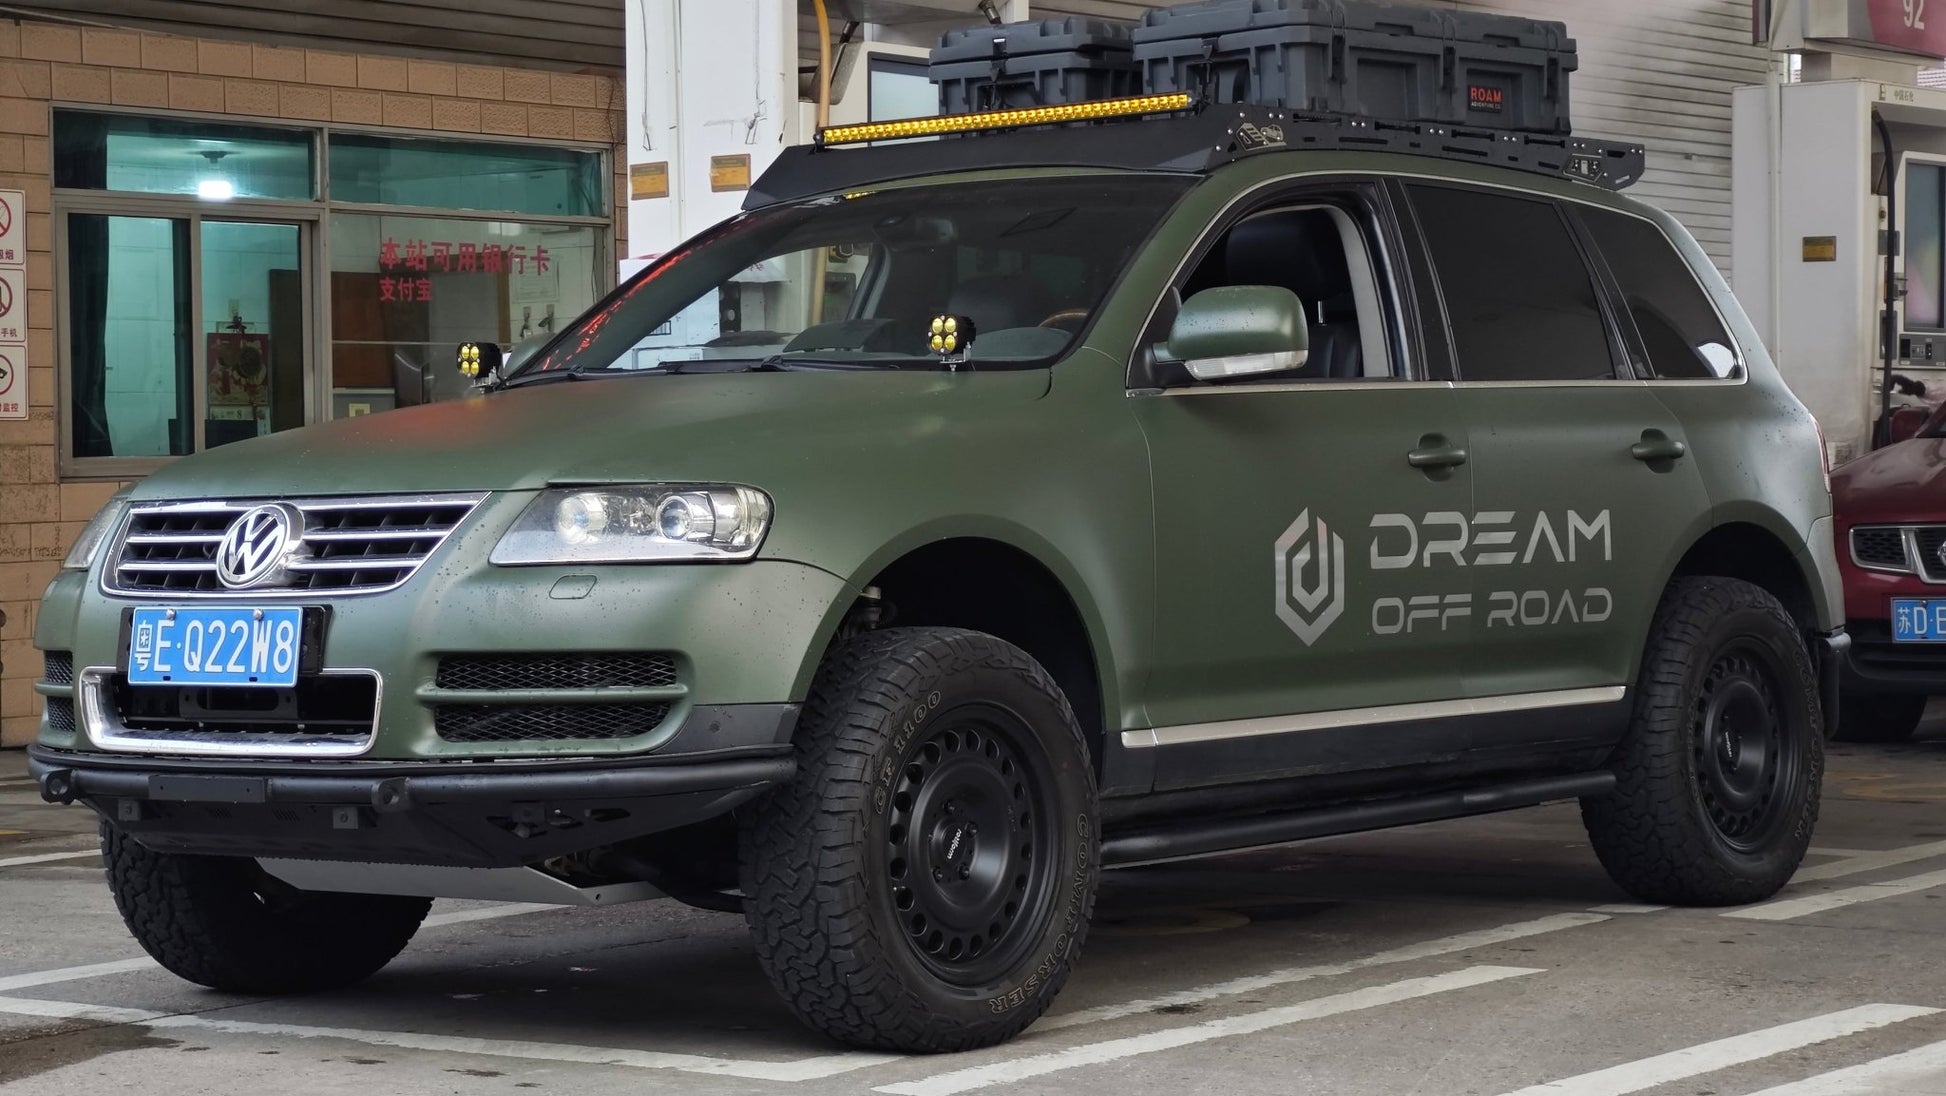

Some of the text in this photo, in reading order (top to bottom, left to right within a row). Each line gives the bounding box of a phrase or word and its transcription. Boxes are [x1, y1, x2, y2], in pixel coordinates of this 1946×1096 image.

[1903, 0, 1925, 30] 92
[1471, 87, 1502, 103] ROAM
[379, 237, 551, 276] 本站可用银行卡
[379, 277, 432, 301] 支付宝
[1369, 509, 1613, 569] DREAM
[1372, 587, 1613, 634] OFF ROAD
[989, 812, 1089, 1015] COMFORSER
